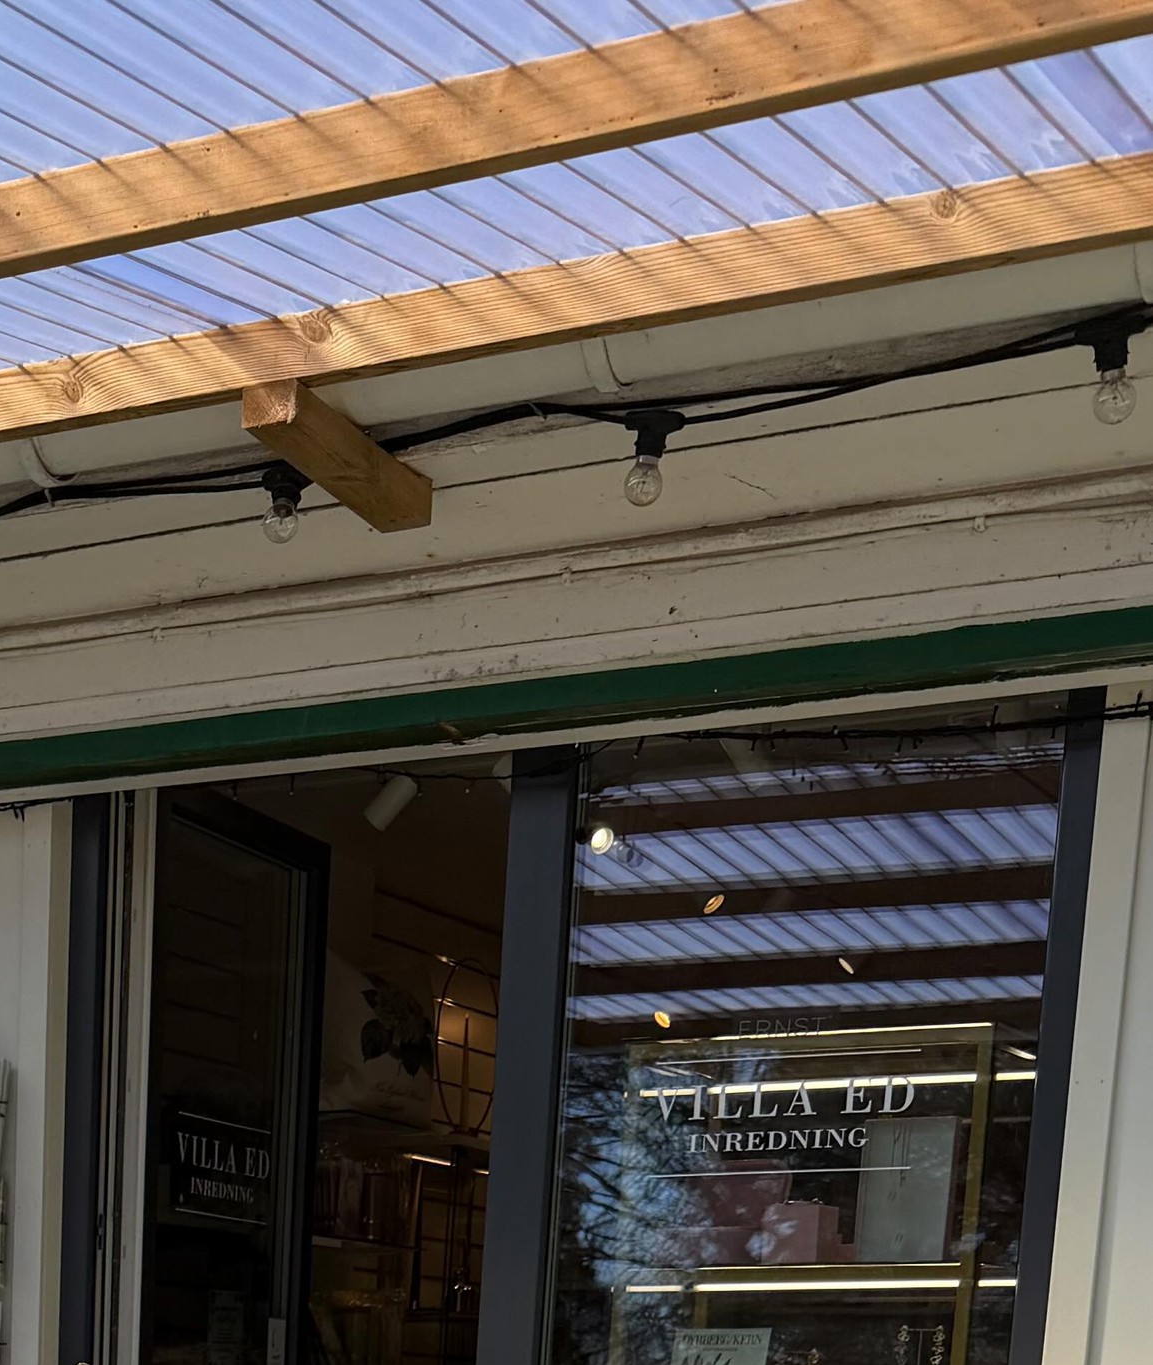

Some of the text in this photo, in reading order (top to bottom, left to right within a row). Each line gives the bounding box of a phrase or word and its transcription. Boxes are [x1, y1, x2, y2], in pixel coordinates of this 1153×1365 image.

[655, 1074, 916, 1122] VILLA ED
[177, 1131, 270, 1179] VILLA ED
[688, 1127, 870, 1153] INREDNING
[190, 1176, 254, 1204] INREDNING
